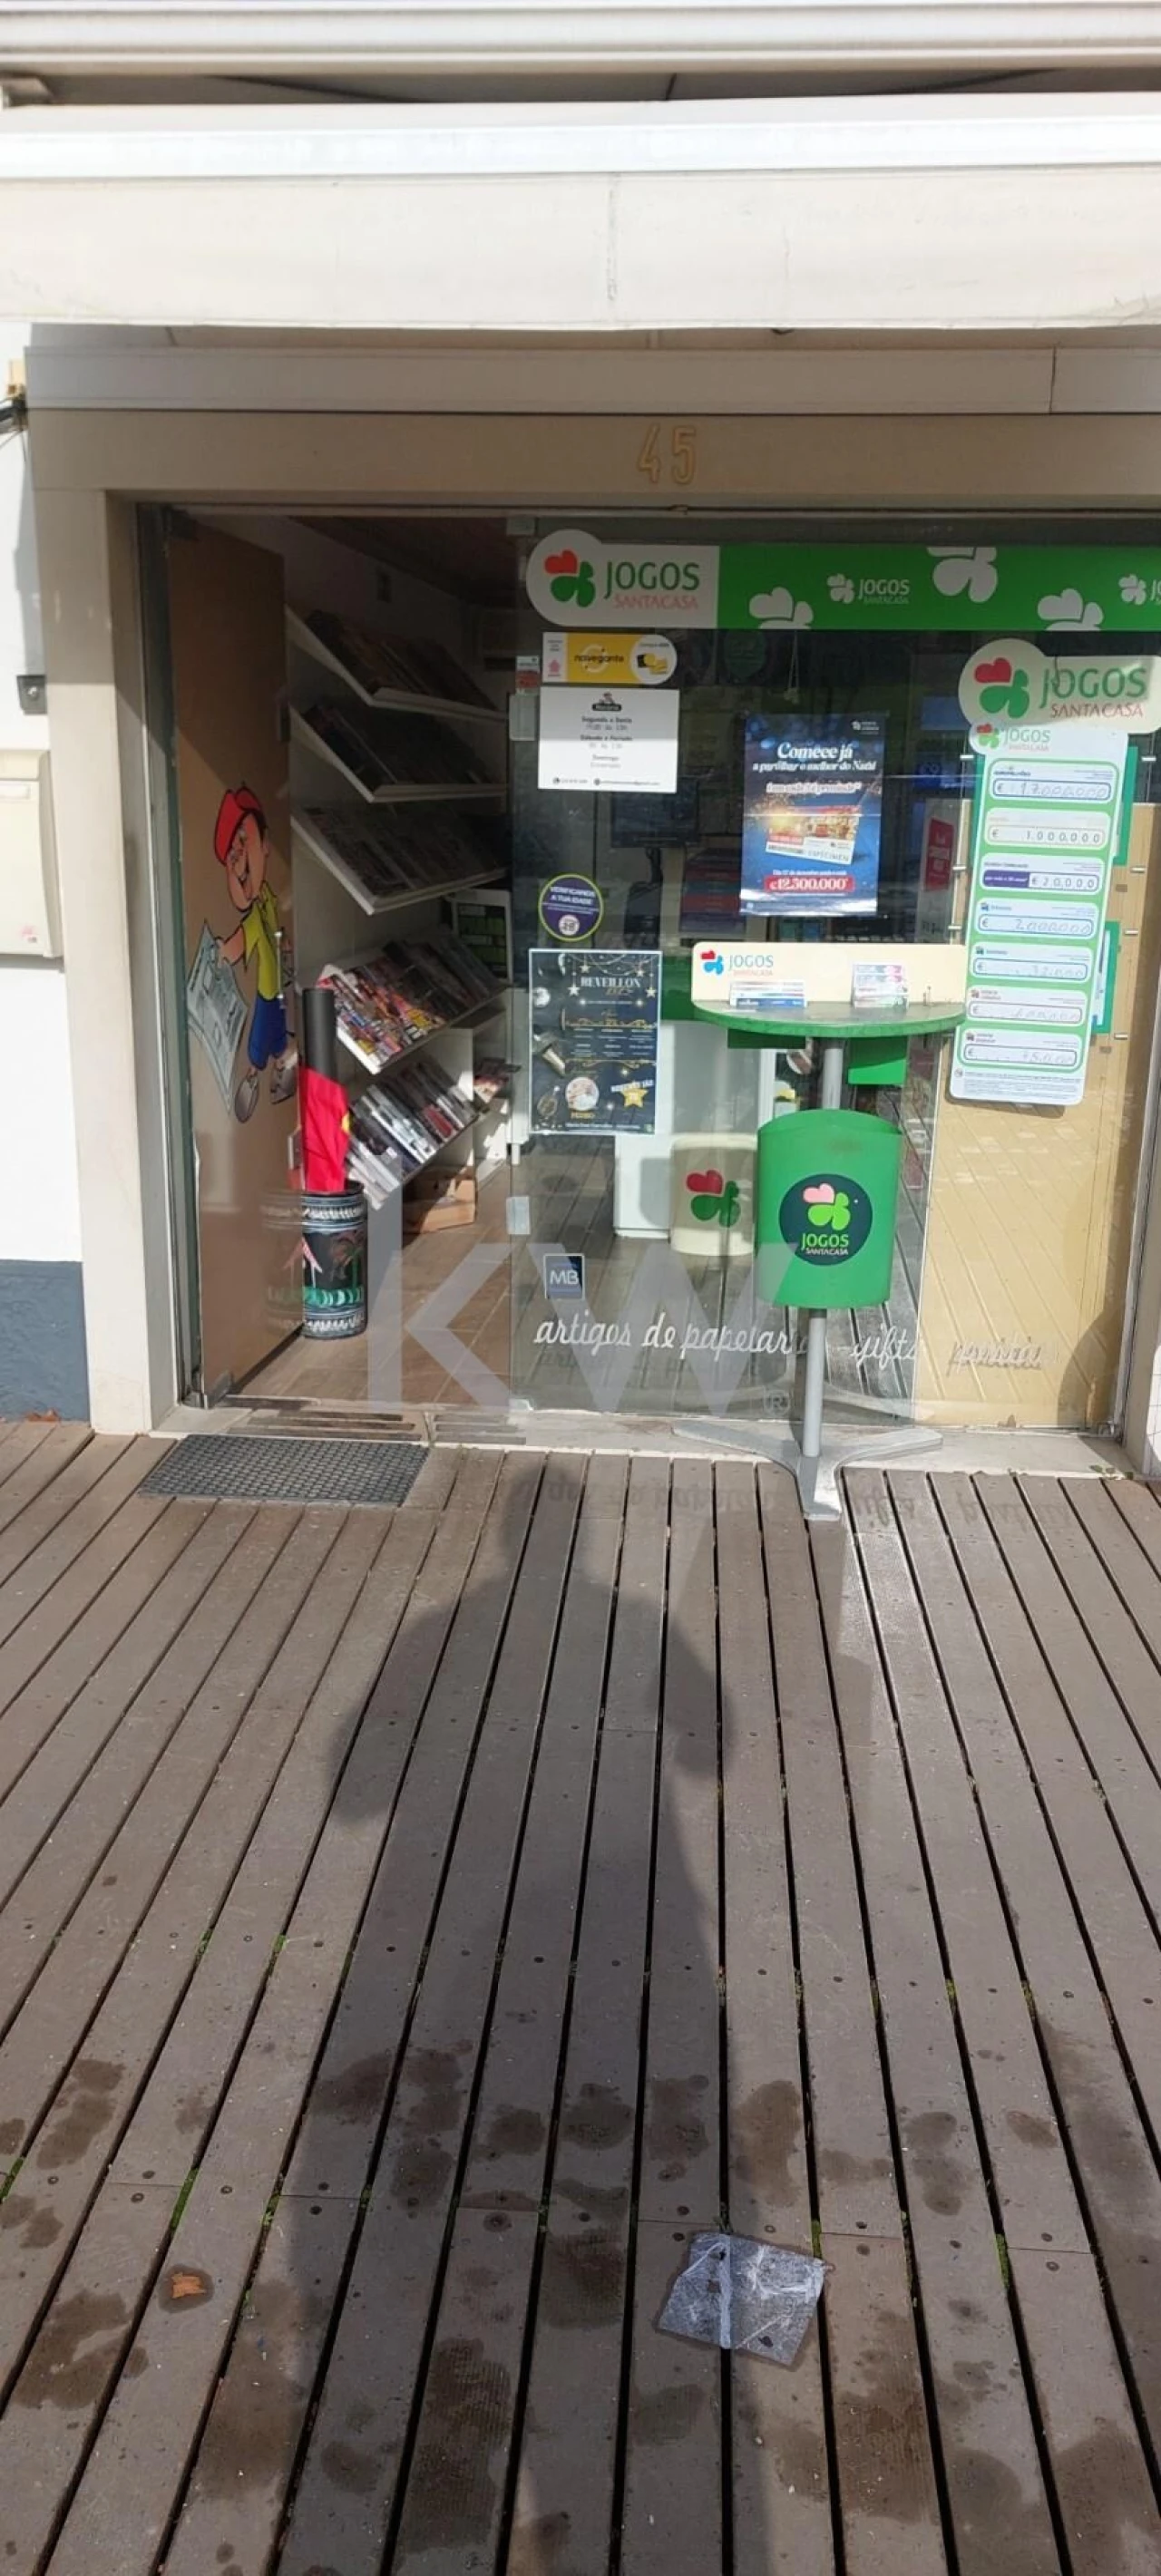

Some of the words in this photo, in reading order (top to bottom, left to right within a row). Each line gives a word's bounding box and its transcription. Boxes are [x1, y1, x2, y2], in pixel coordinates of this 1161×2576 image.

[636, 423, 698, 484] 45
[603, 560, 700, 599] JOGOS
[858, 578, 910, 599] JOGOS
[613, 594, 698, 609] SANTACASA
[1039, 667, 1146, 708] JOGOS
[1050, 703, 1144, 717] SANTACASA
[1003, 727, 1051, 745] JOGOS
[777, 741, 838, 759] Comece
[838, 742, 854, 763] já
[728, 955, 774, 971] JOGOS
[801, 1233, 850, 1251] JOGOS
[805, 1247, 850, 1257] SANTACASA
[550, 1269, 580, 1285] MB
[533, 1309, 631, 1356] artigos
[641, 1312, 677, 1349] de
